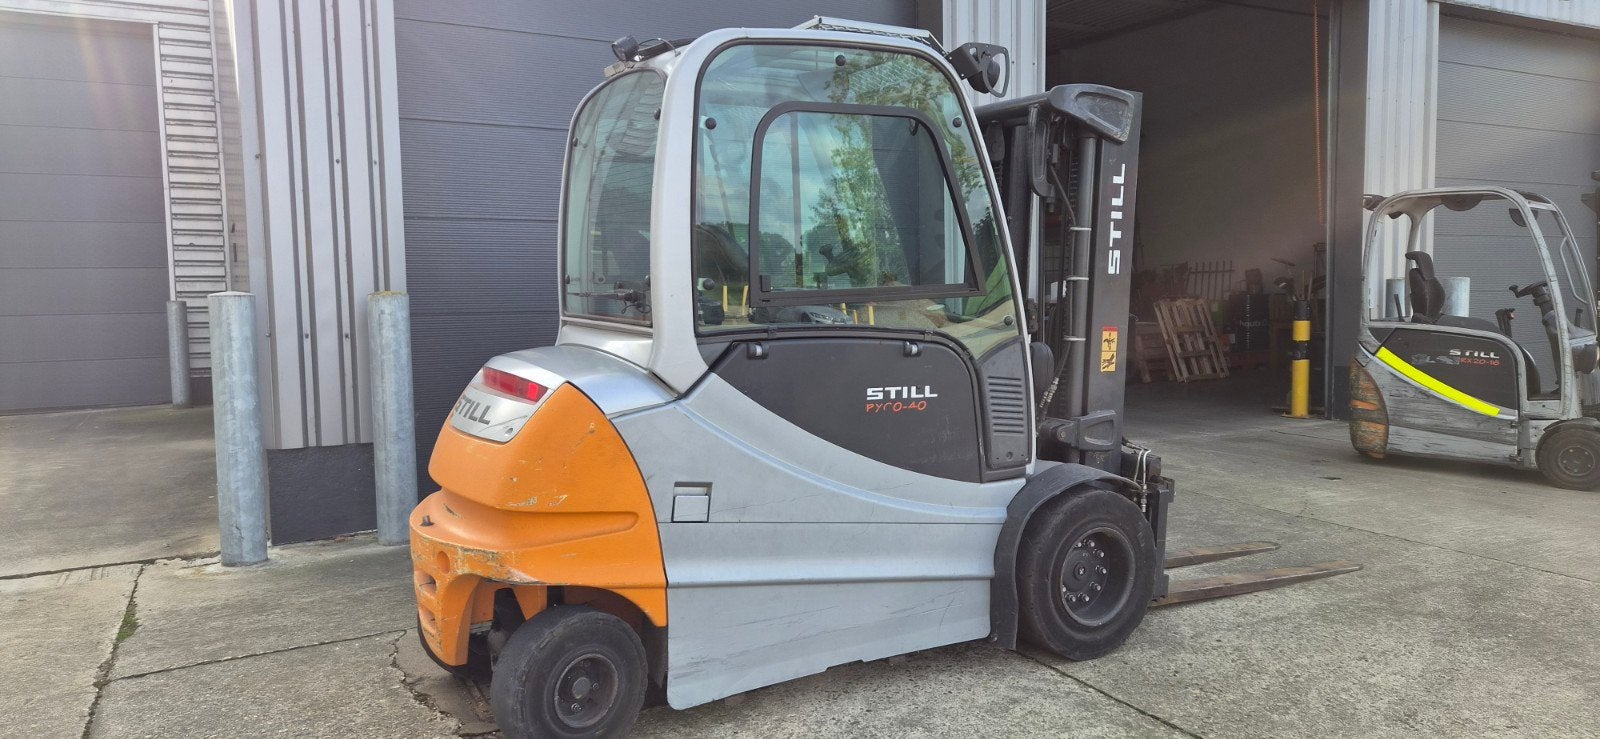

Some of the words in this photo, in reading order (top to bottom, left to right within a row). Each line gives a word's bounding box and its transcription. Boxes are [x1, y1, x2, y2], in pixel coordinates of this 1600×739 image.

[1108, 163, 1126, 275] STILL
[1449, 348, 1500, 359] STILL
[866, 385, 938, 400] STILL
